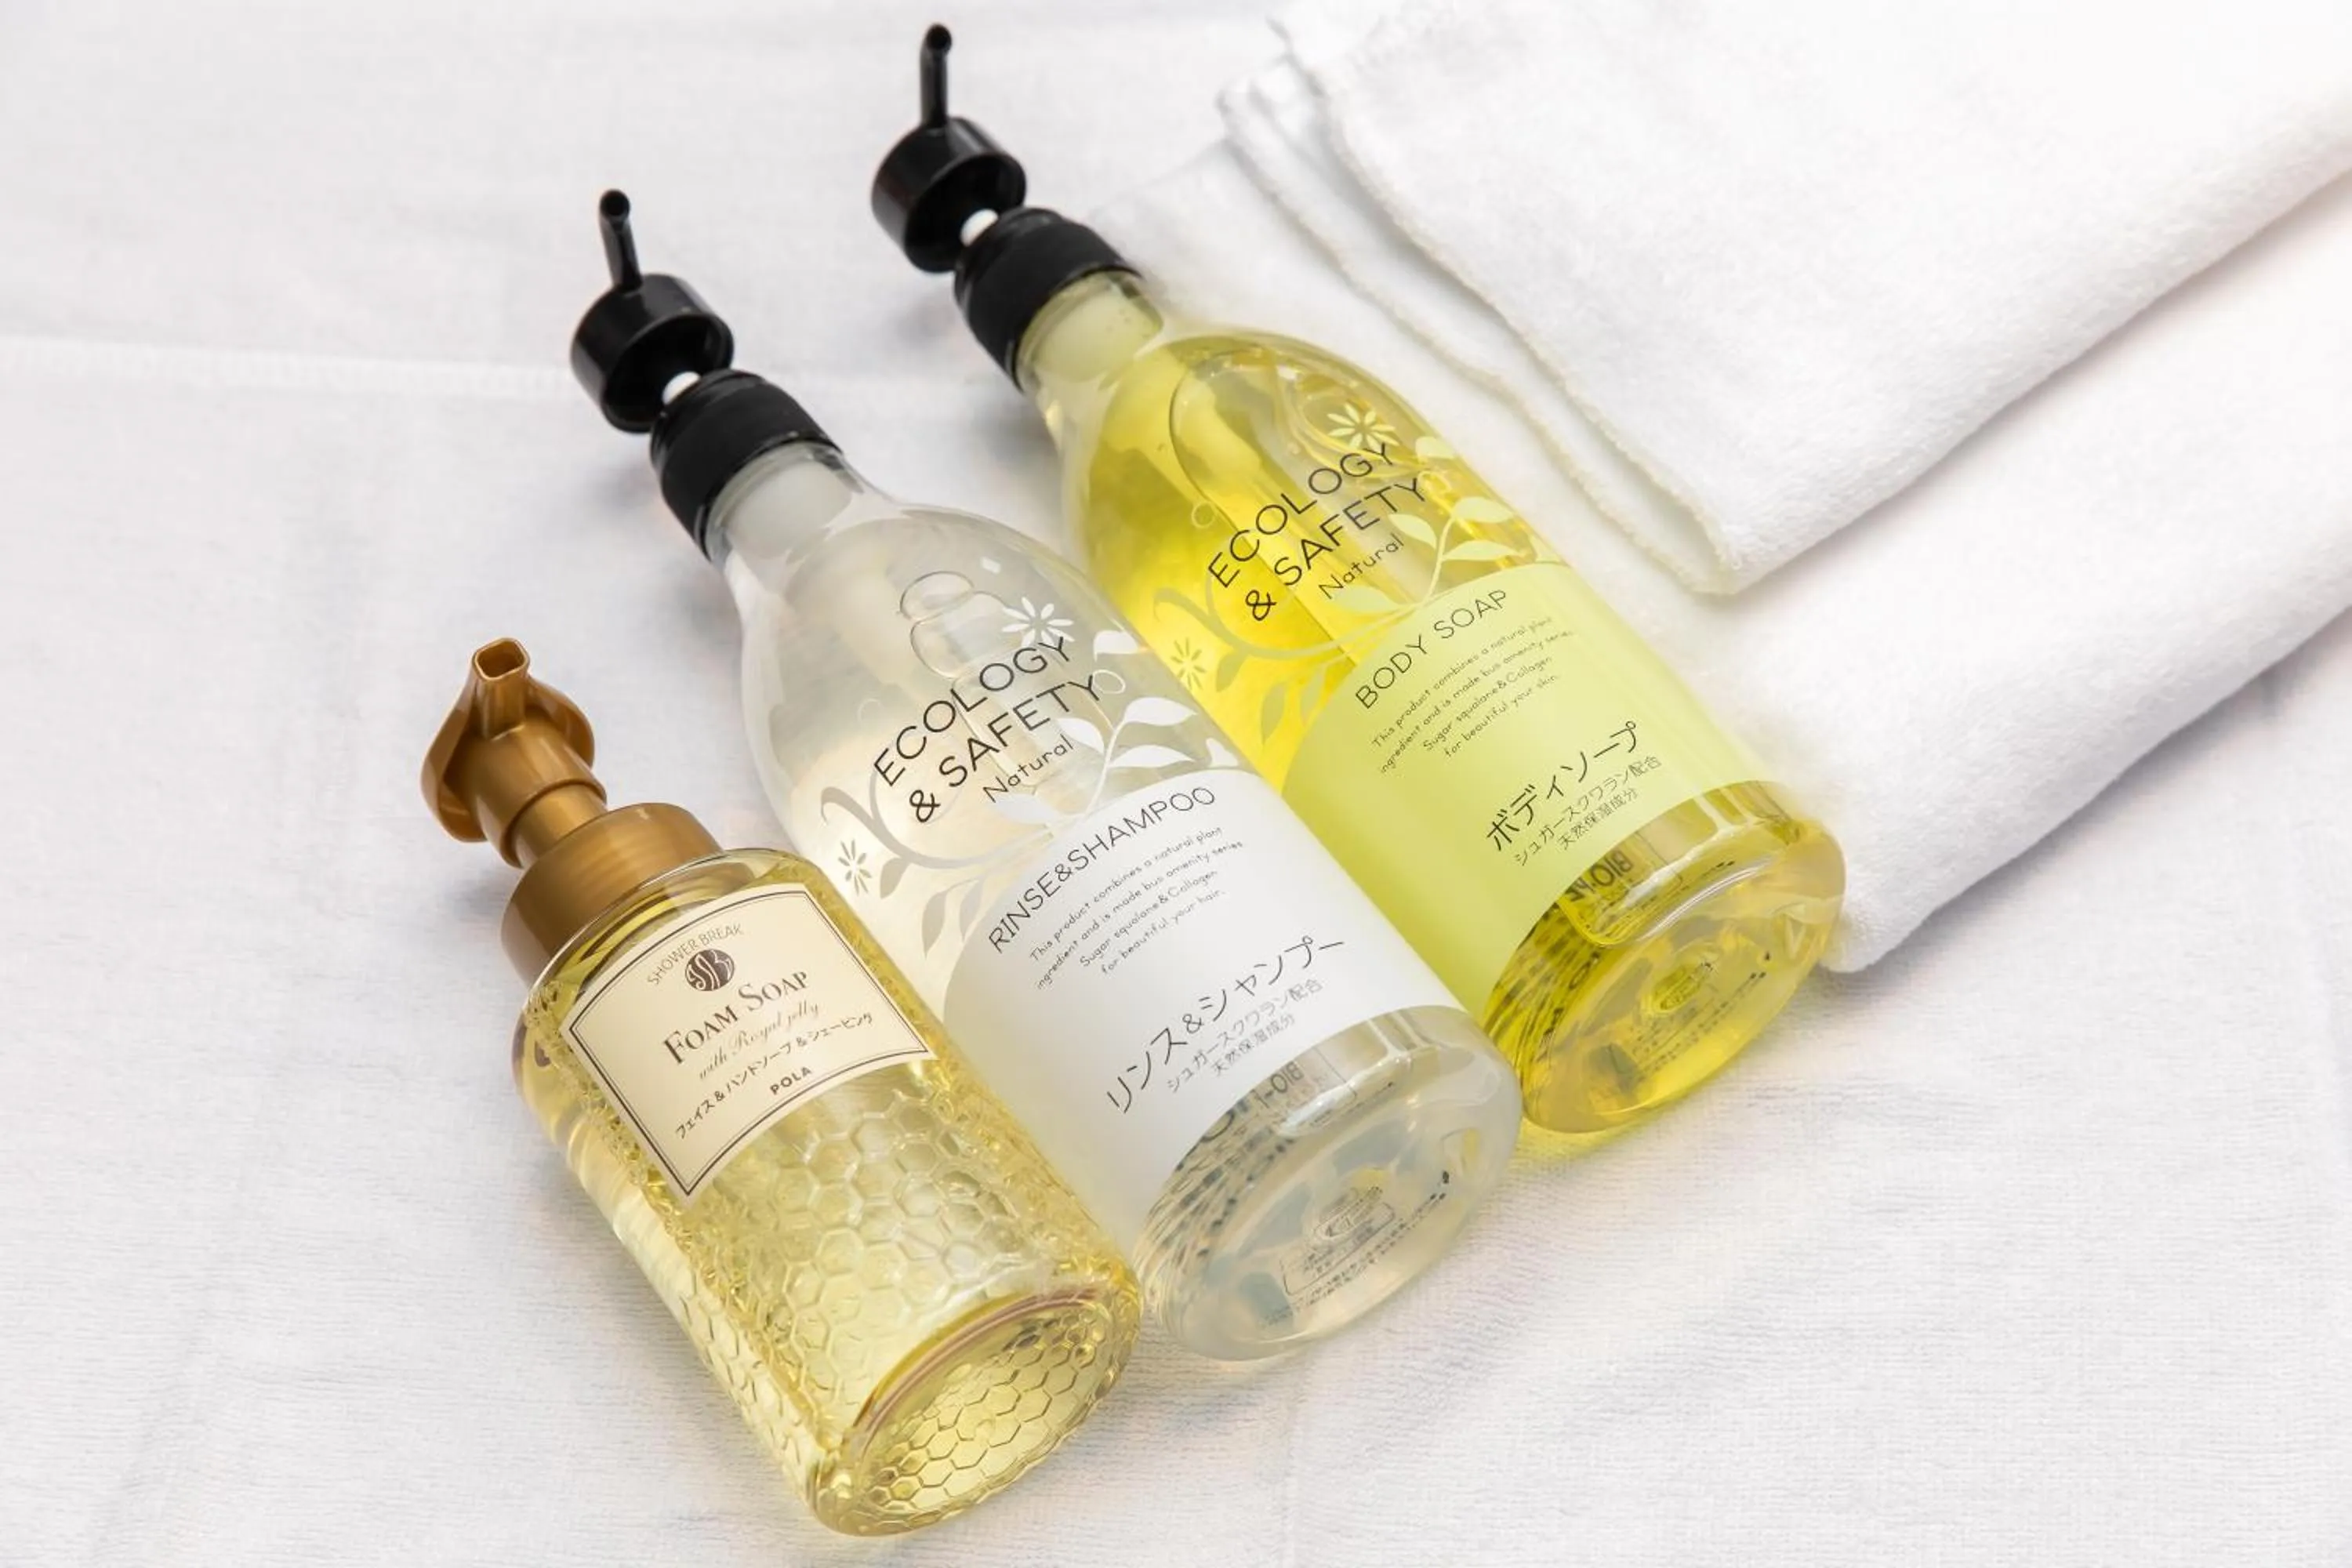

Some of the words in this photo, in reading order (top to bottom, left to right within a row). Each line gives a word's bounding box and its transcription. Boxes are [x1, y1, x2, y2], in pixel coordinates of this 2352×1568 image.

[1208, 442, 1394, 587] ECOLOGY
[1245, 590, 1276, 622] &
[1274, 477, 1426, 586] SAFETY
[1319, 535, 1405, 601] Natural
[1356, 634, 1428, 709] BODY
[1434, 590, 1507, 639] SOAP
[1372, 728, 1395, 748] This
[1397, 690, 1431, 728] product
[1434, 653, 1479, 690] combines
[1482, 648, 1489, 656] a
[1491, 626, 1526, 651] natural
[1381, 726, 1421, 774] ingredient
[1423, 706, 1441, 727] and
[1443, 698, 1451, 707] is
[1453, 677, 1480, 698] made
[1503, 641, 1544, 665] amenity
[873, 636, 1069, 787] ECOLOGY
[909, 789, 941, 822] &
[938, 674, 1100, 787] SAFETY
[982, 733, 1074, 803] Natural
[1424, 723, 1453, 751] Sugar
[1444, 741, 1462, 758] for
[1465, 702, 1508, 742] beautiful
[1511, 688, 1533, 707] your
[1487, 720, 1636, 851] ボディソープ
[1513, 755, 1663, 866] シュガースクワラン配合
[1558, 787, 1638, 851] 天然保湿成分
[988, 787, 1215, 954] RINSE&SHAMPOO
[1030, 941, 1052, 961] This
[1054, 902, 1091, 942] product
[1094, 866, 1142, 903] combines
[1154, 837, 1194, 862] natural
[1196, 826, 1222, 845] plant
[1037, 941, 1080, 990] ingredient
[1080, 921, 1100, 940] and
[1102, 913, 1111, 924] is
[1112, 890, 1142, 913] made
[1166, 853, 1210, 877] amenity
[1080, 940, 1112, 967] Sugar
[1114, 870, 1218, 939] squalane&Collagen
[648, 938, 699, 985] SHOWER
[698, 923, 742, 946] BREAK
[1101, 960, 1119, 975] for
[1122, 918, 1169, 960] beautiful
[1172, 903, 1195, 925] your
[700, 1046, 728, 1080] with
[731, 1015, 782, 1056] Royal
[786, 1000, 819, 1027] jelly
[770, 1066, 812, 1094] POLA
[1107, 935, 1344, 1114] リンス&シャンプー
[1167, 978, 1323, 1093] シュガースクワラン配合
